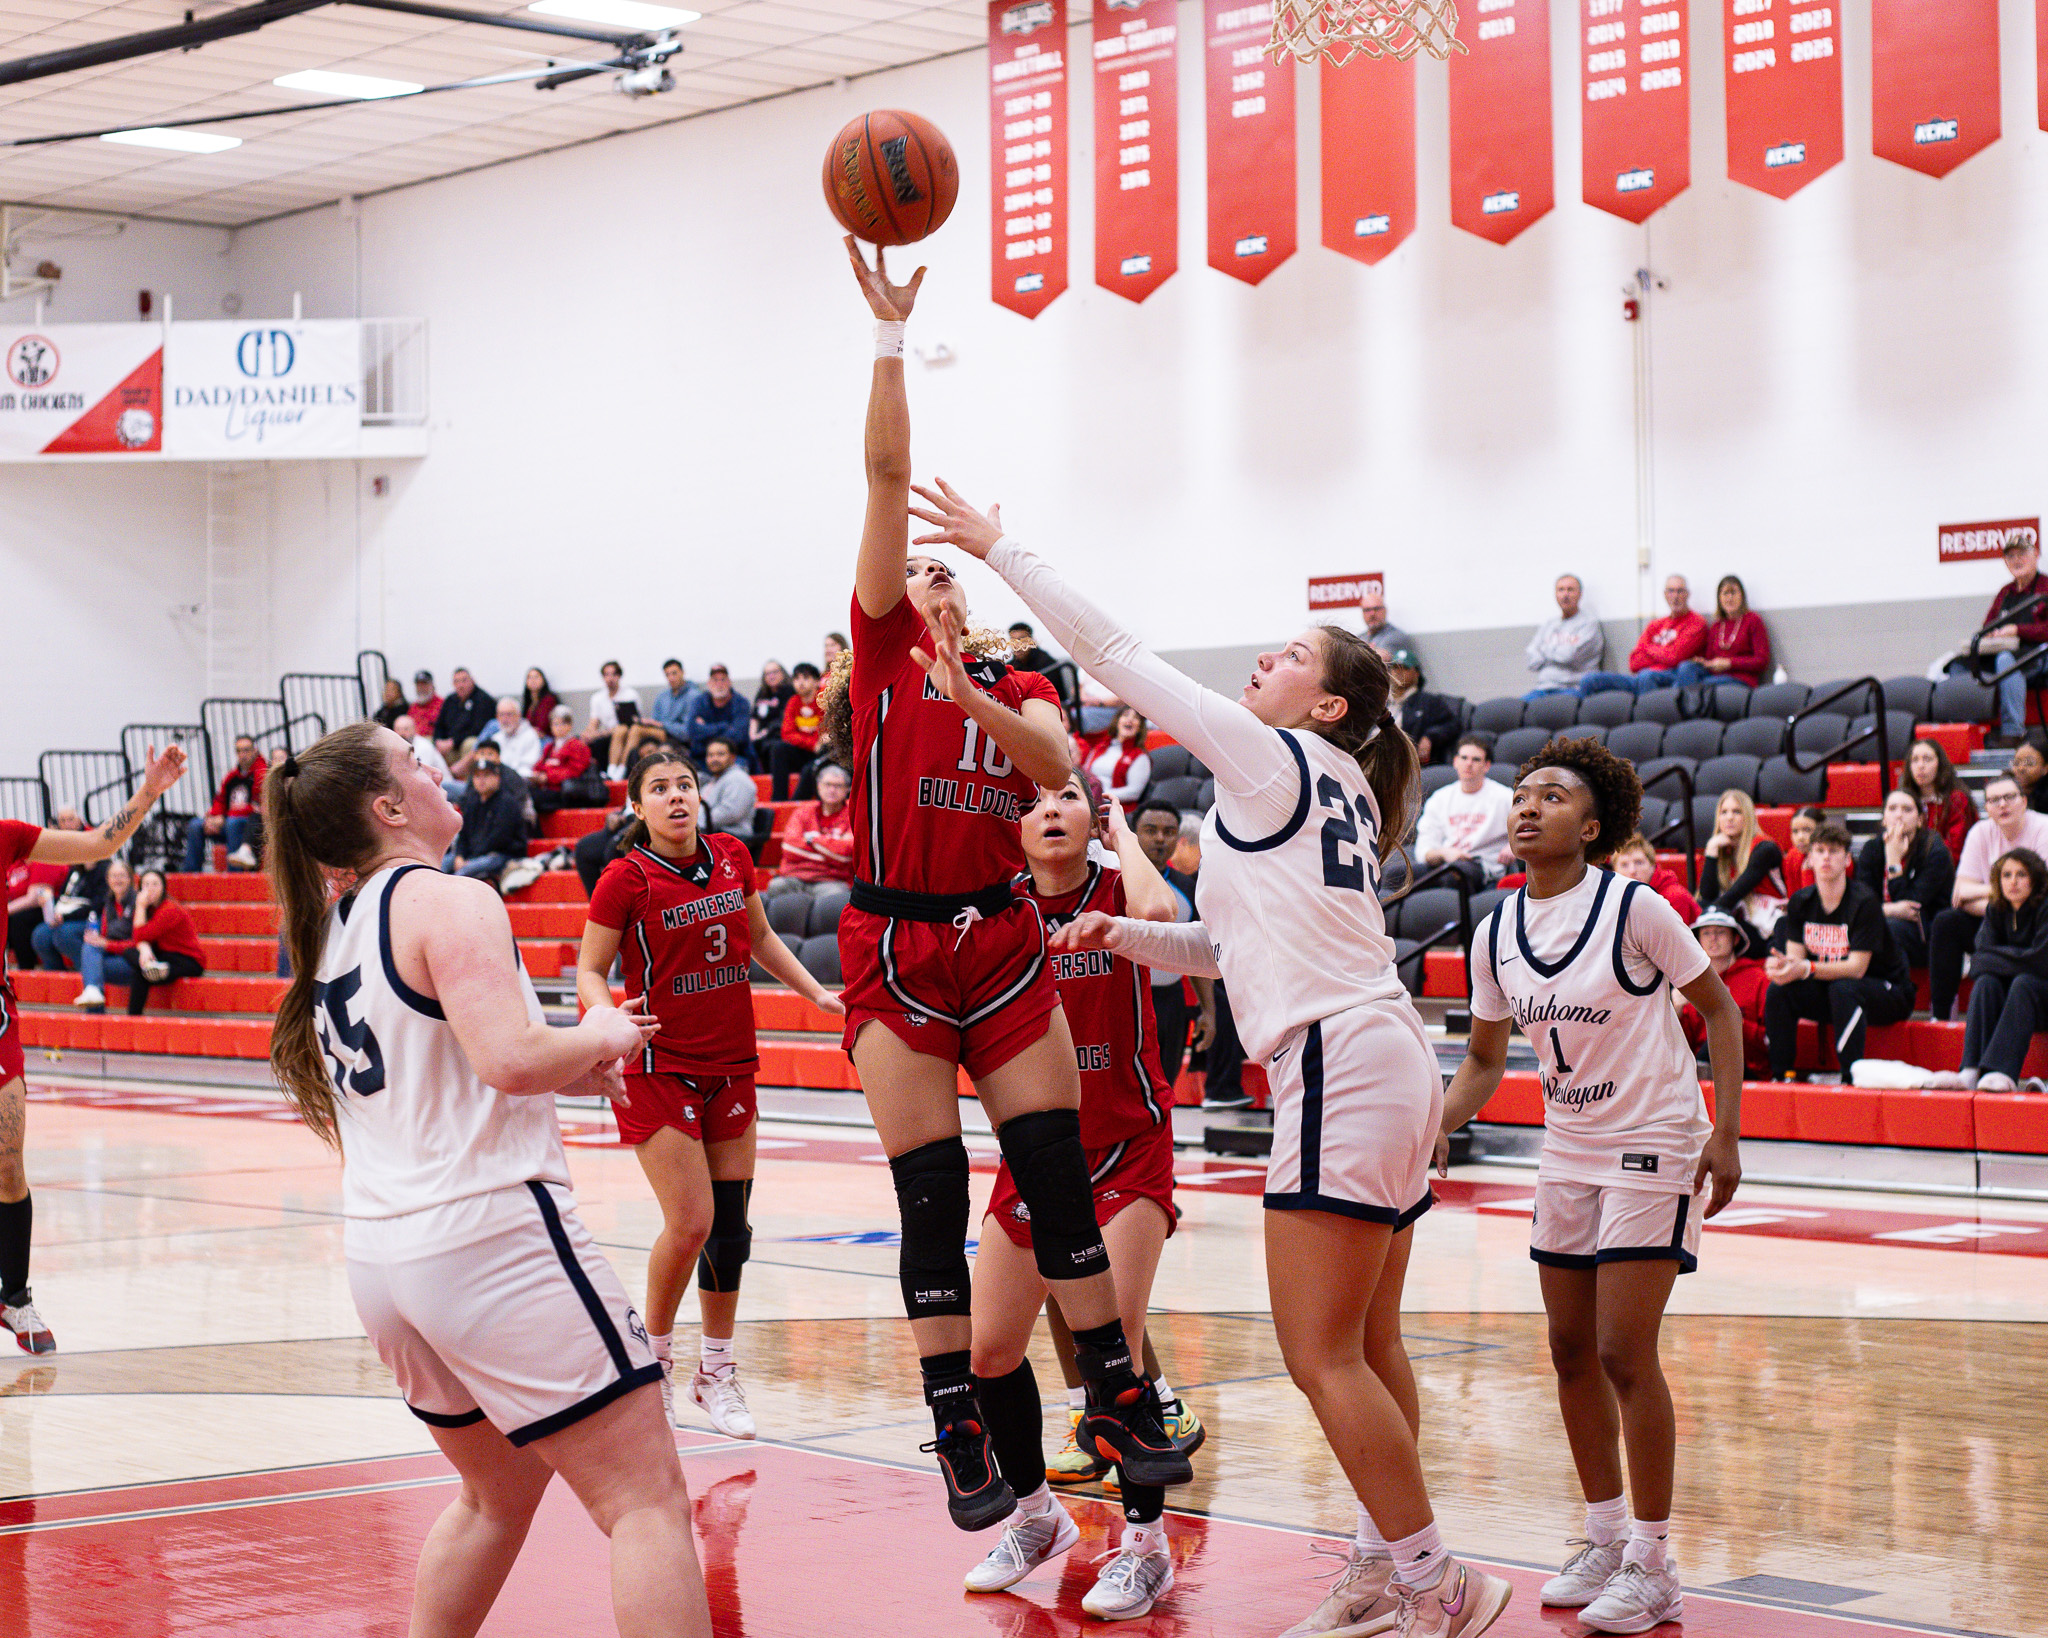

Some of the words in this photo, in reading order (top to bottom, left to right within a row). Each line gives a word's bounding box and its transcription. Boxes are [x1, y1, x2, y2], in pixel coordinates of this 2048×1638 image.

[1587, 21, 1626, 46] 2014
[1733, 48, 1776, 73] 2024
[1791, 37, 1834, 63] 2025
[1587, 76, 1627, 102] 2024
[704, 923, 727, 964] 3
[1511, 994, 1612, 1029] Oklahoma
[1549, 1027, 1573, 1073] 1
[1540, 1071, 1617, 1113] Wesleyan
